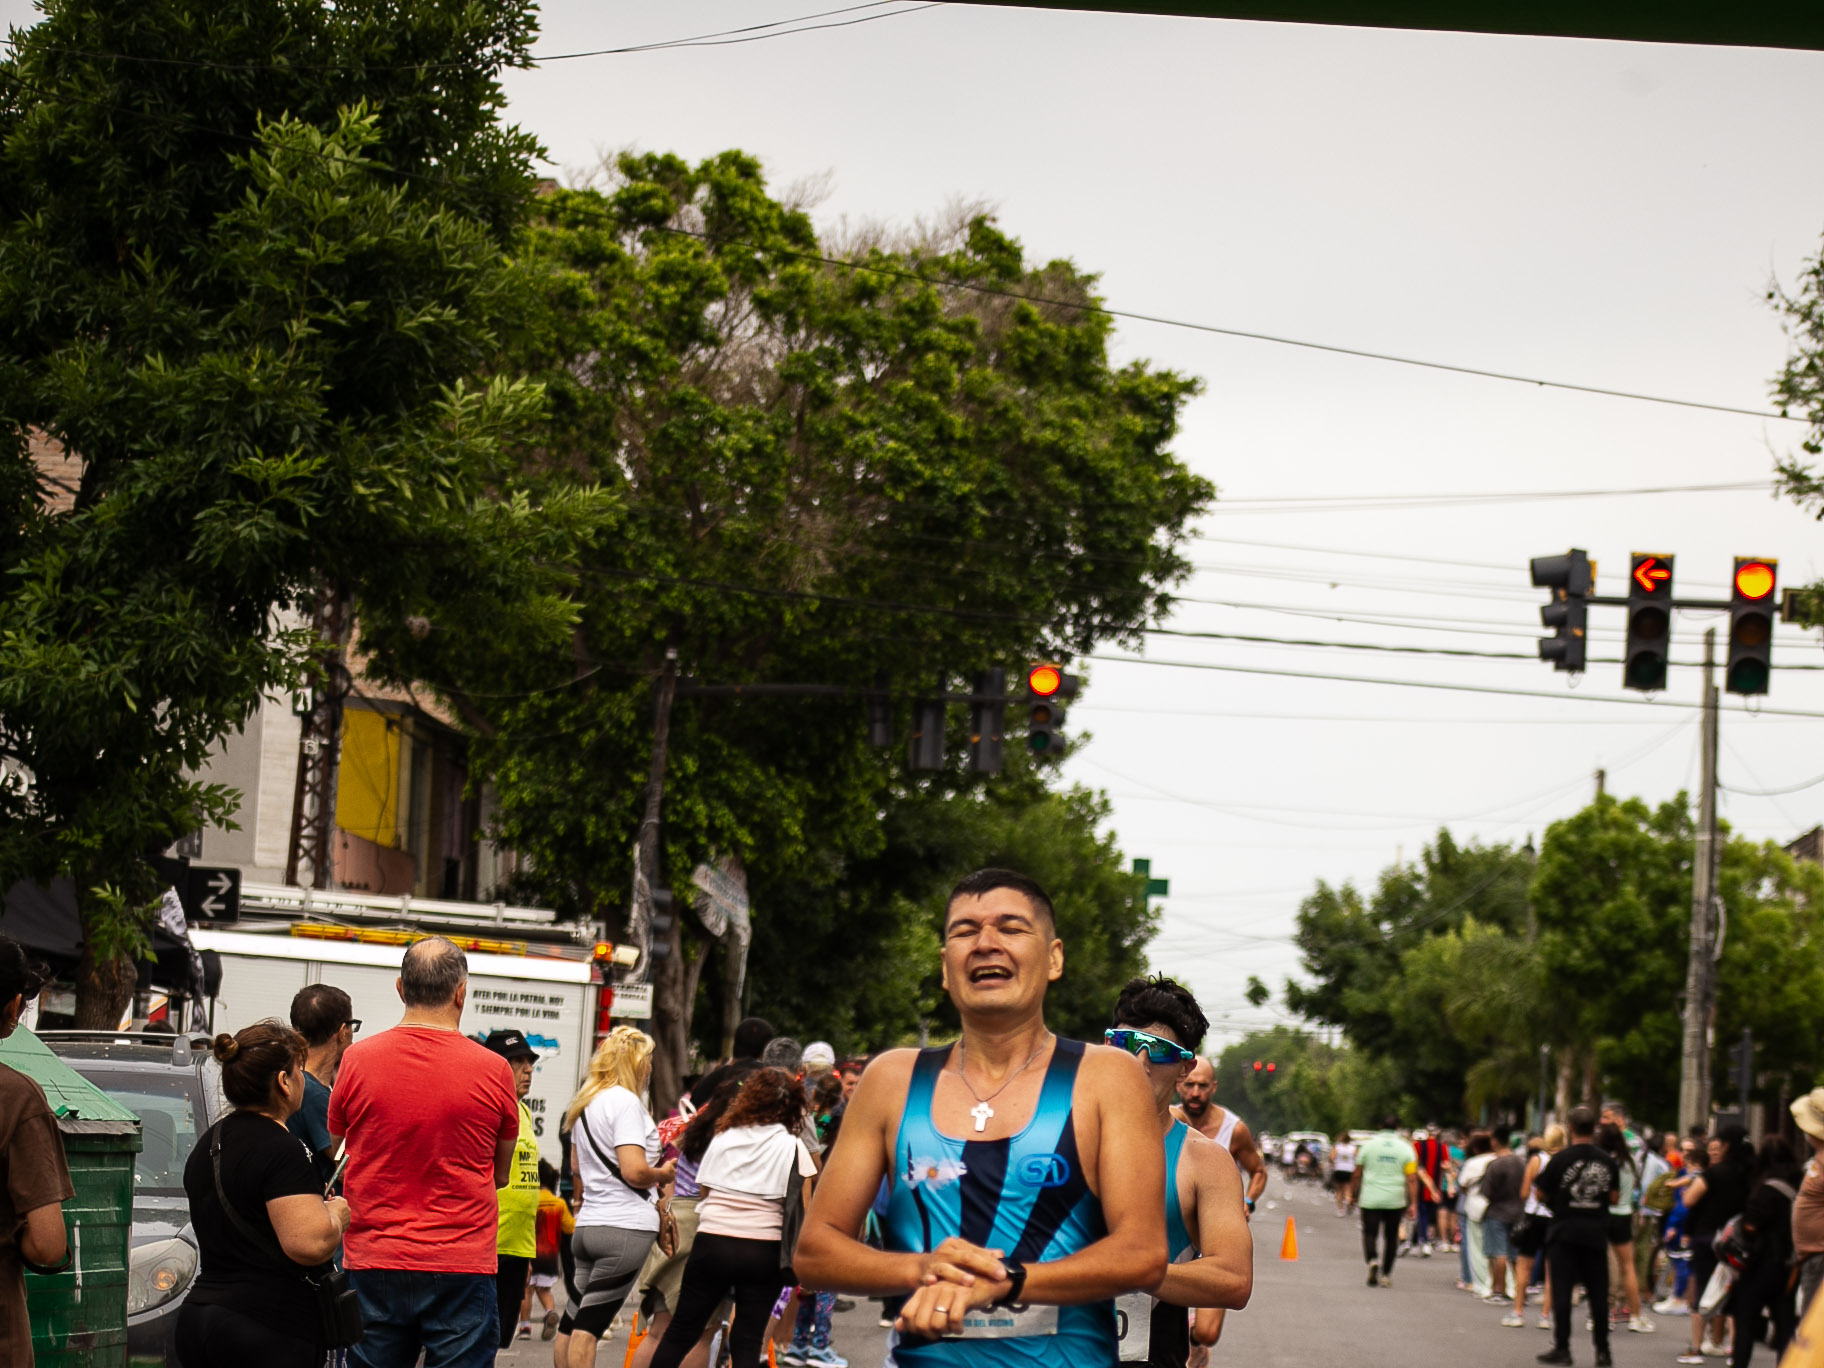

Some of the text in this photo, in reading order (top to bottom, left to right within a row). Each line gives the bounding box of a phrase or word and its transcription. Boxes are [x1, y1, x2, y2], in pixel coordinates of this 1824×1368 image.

[493, 991, 507, 1001] POR
[509, 993, 517, 1002] LA
[481, 1005, 513, 1015] SIEMPRE
[515, 1007, 530, 1017] POR
[532, 1009, 540, 1018] LA
